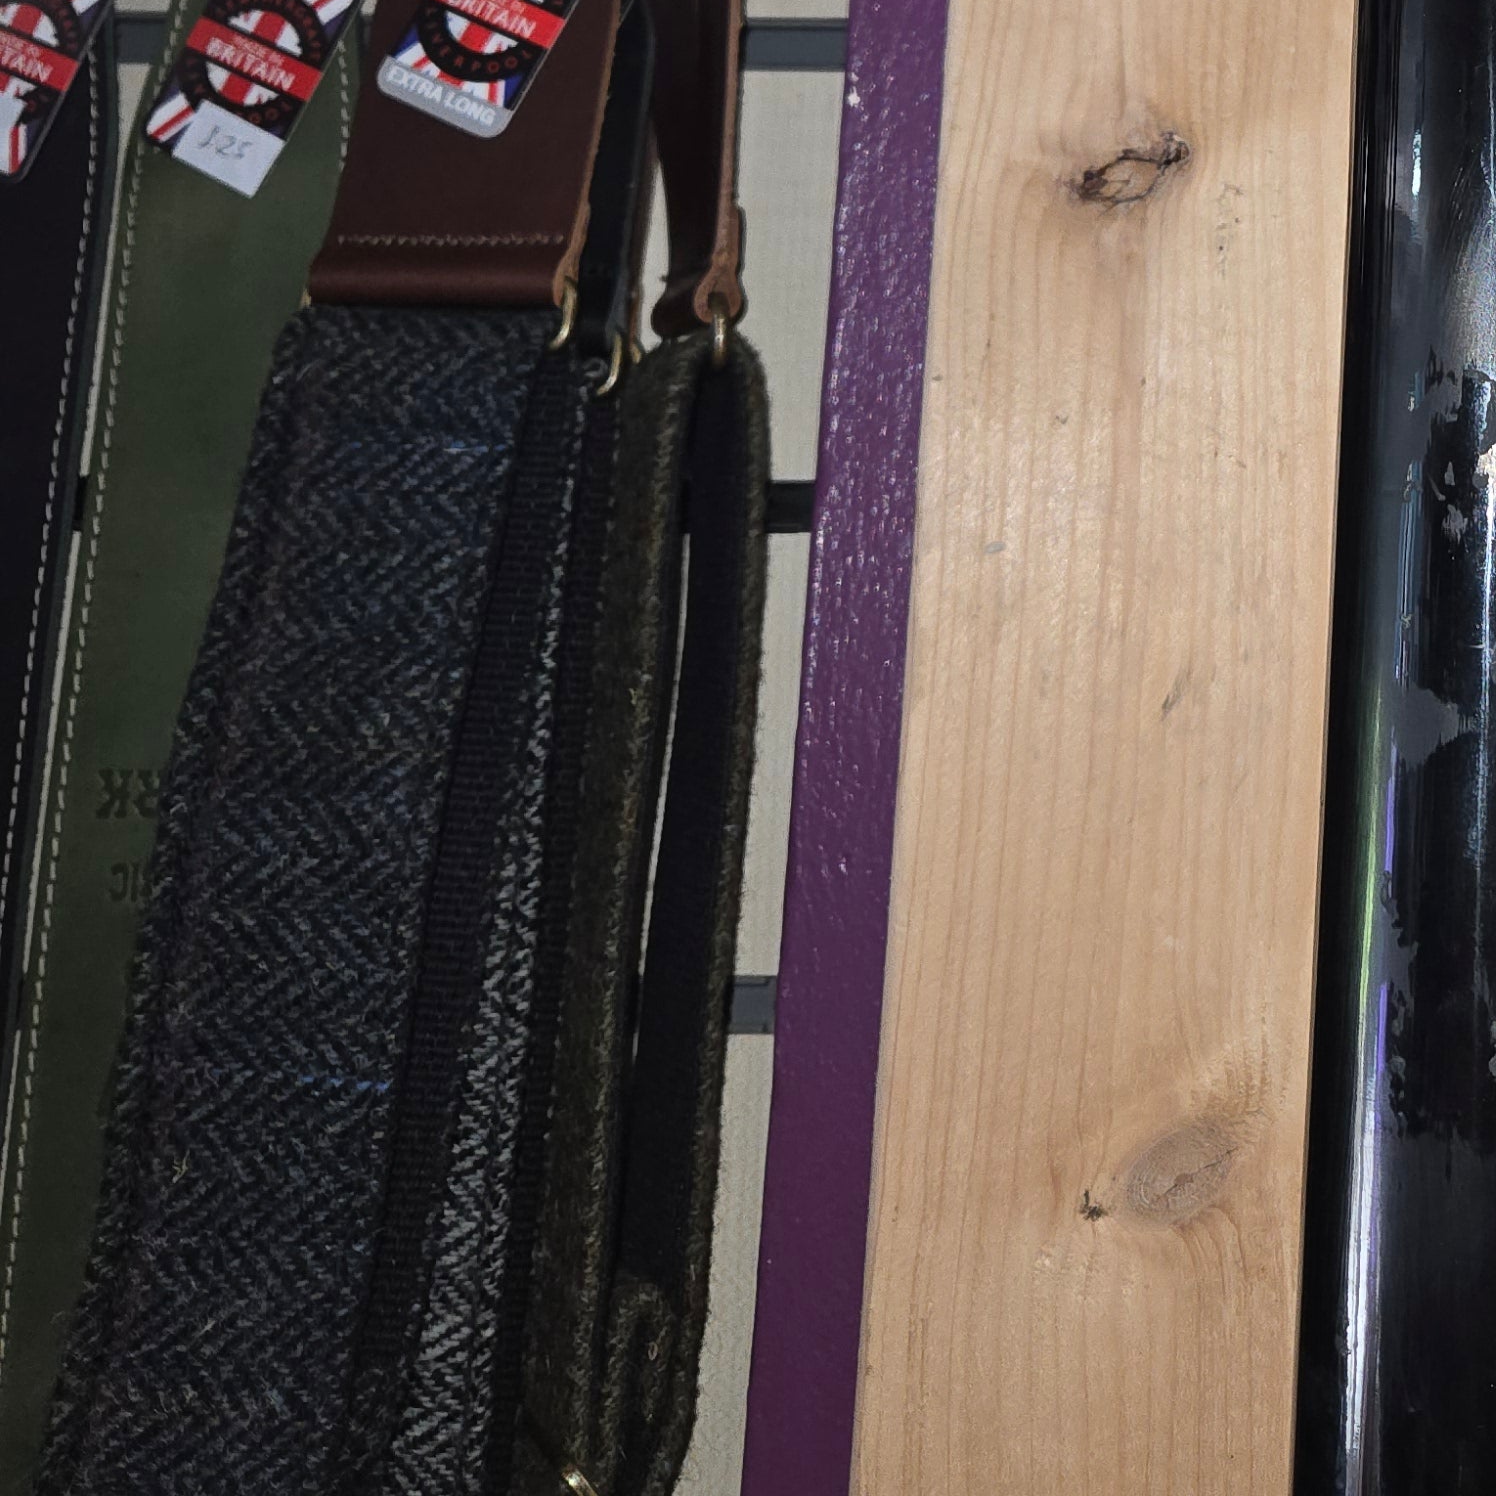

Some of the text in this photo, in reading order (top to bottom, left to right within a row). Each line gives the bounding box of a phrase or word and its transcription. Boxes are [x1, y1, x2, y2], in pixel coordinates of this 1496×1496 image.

[0, 46, 53, 83] TAIN
[206, 37, 296, 90] BRITAIN
[425, 5, 534, 72] LIVERPOOL
[387, 66, 496, 126] EXTRA LONG
